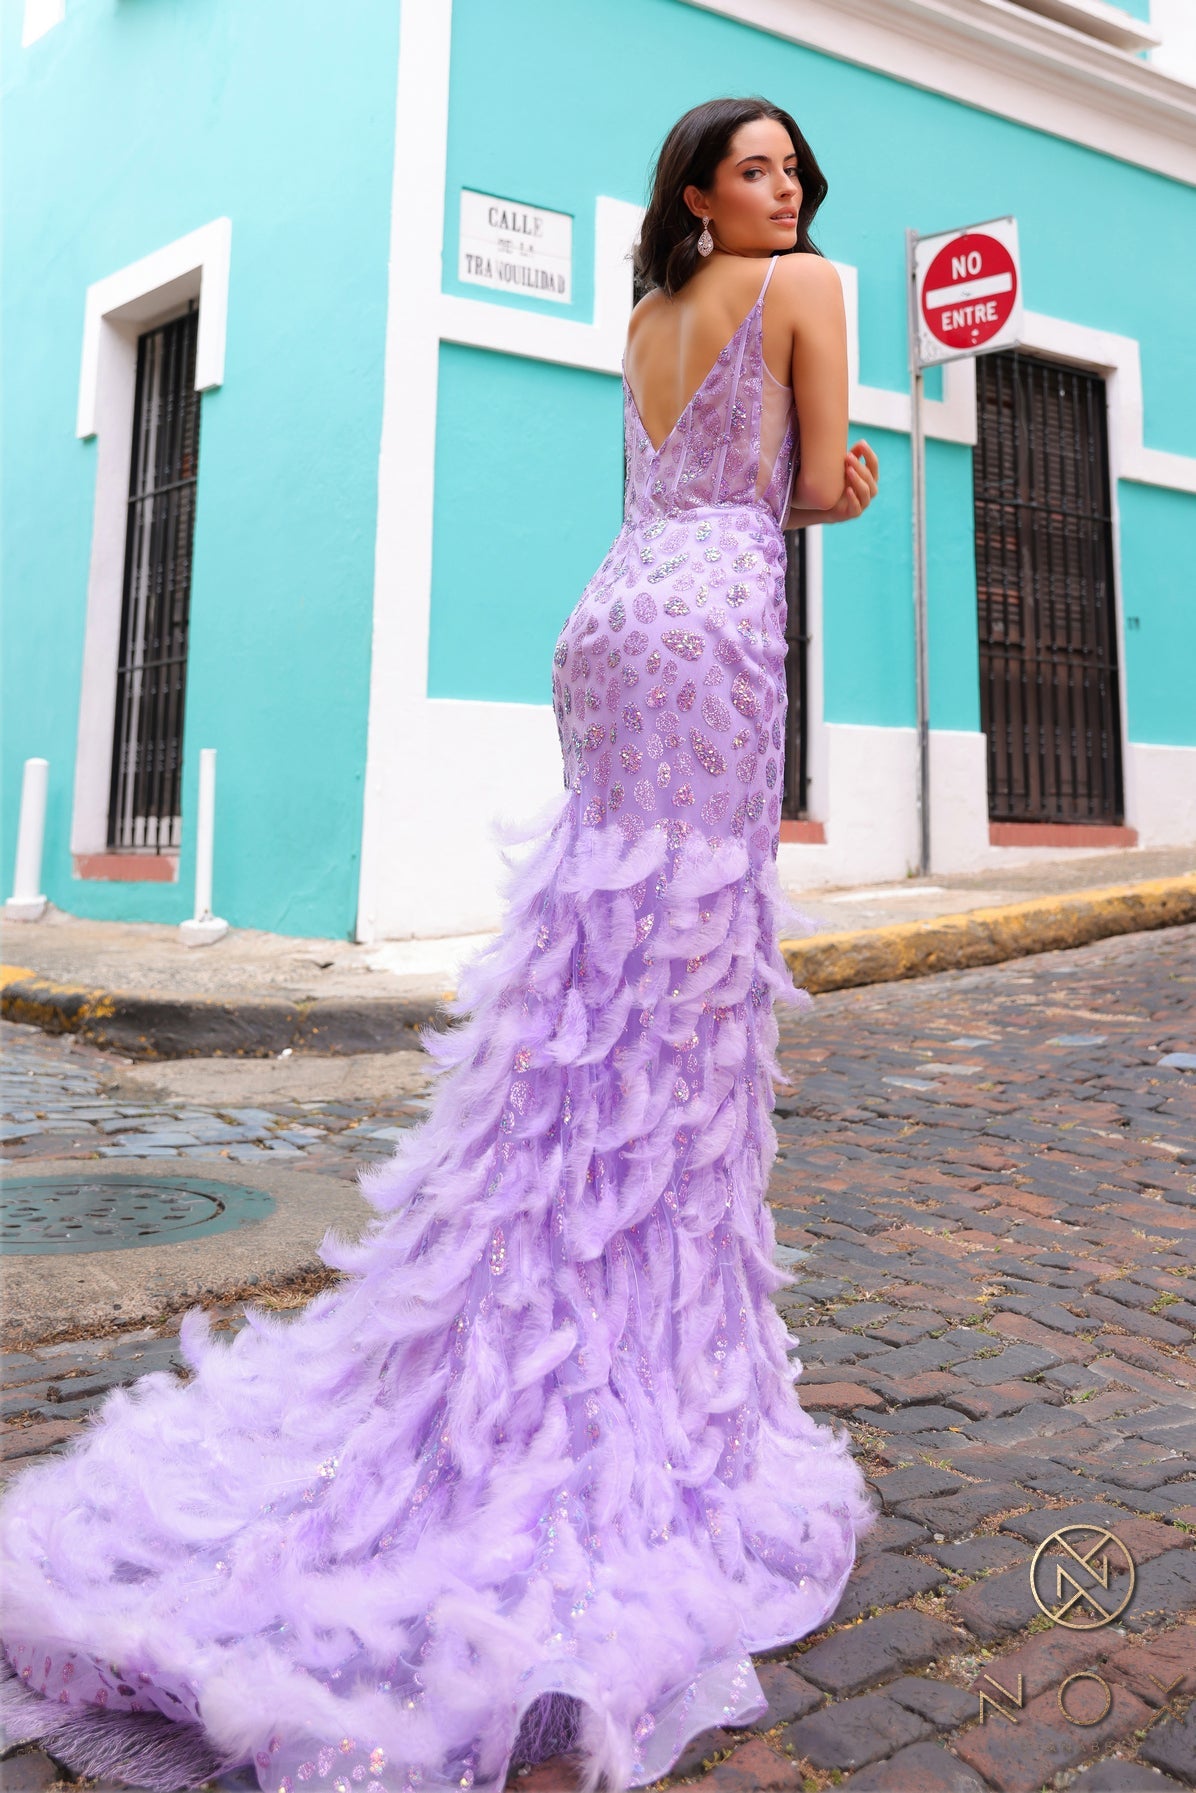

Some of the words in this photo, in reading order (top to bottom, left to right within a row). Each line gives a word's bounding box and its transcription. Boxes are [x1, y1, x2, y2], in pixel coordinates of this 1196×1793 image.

[488, 206, 543, 237] CALLE
[951, 250, 982, 280] NO
[941, 301, 998, 332] ENTRE
